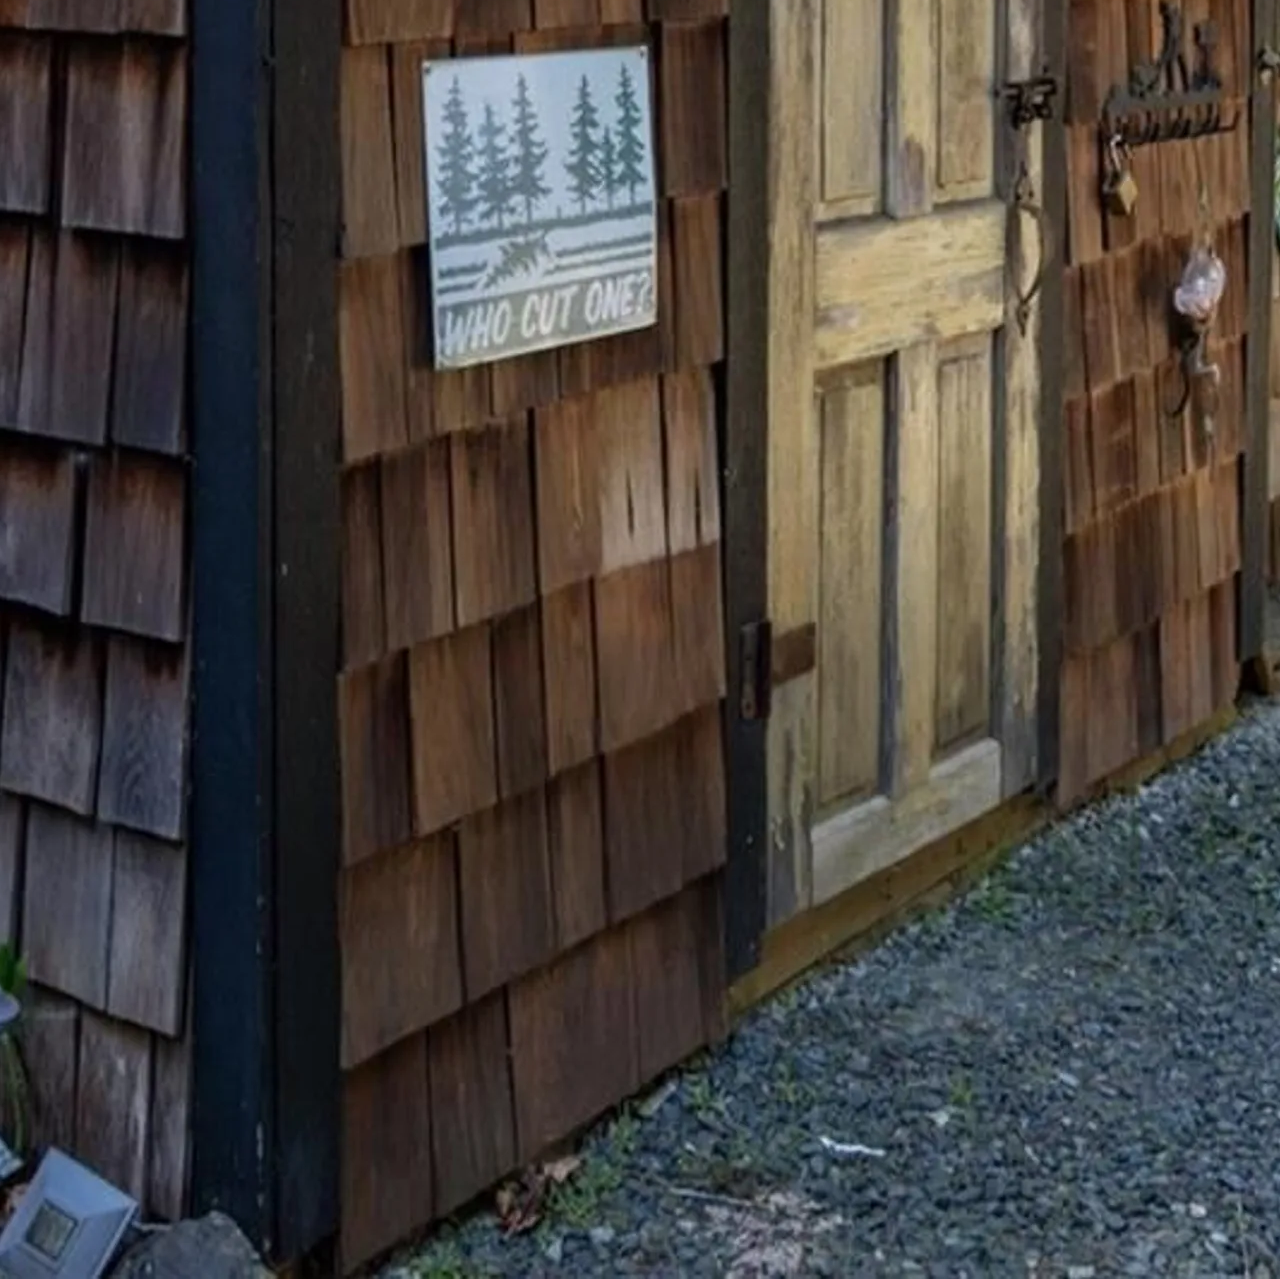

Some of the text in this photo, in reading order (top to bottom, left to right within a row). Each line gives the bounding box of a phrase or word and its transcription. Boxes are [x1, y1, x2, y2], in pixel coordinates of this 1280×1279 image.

[441, 271, 653, 356] WHO CUT ONE?
